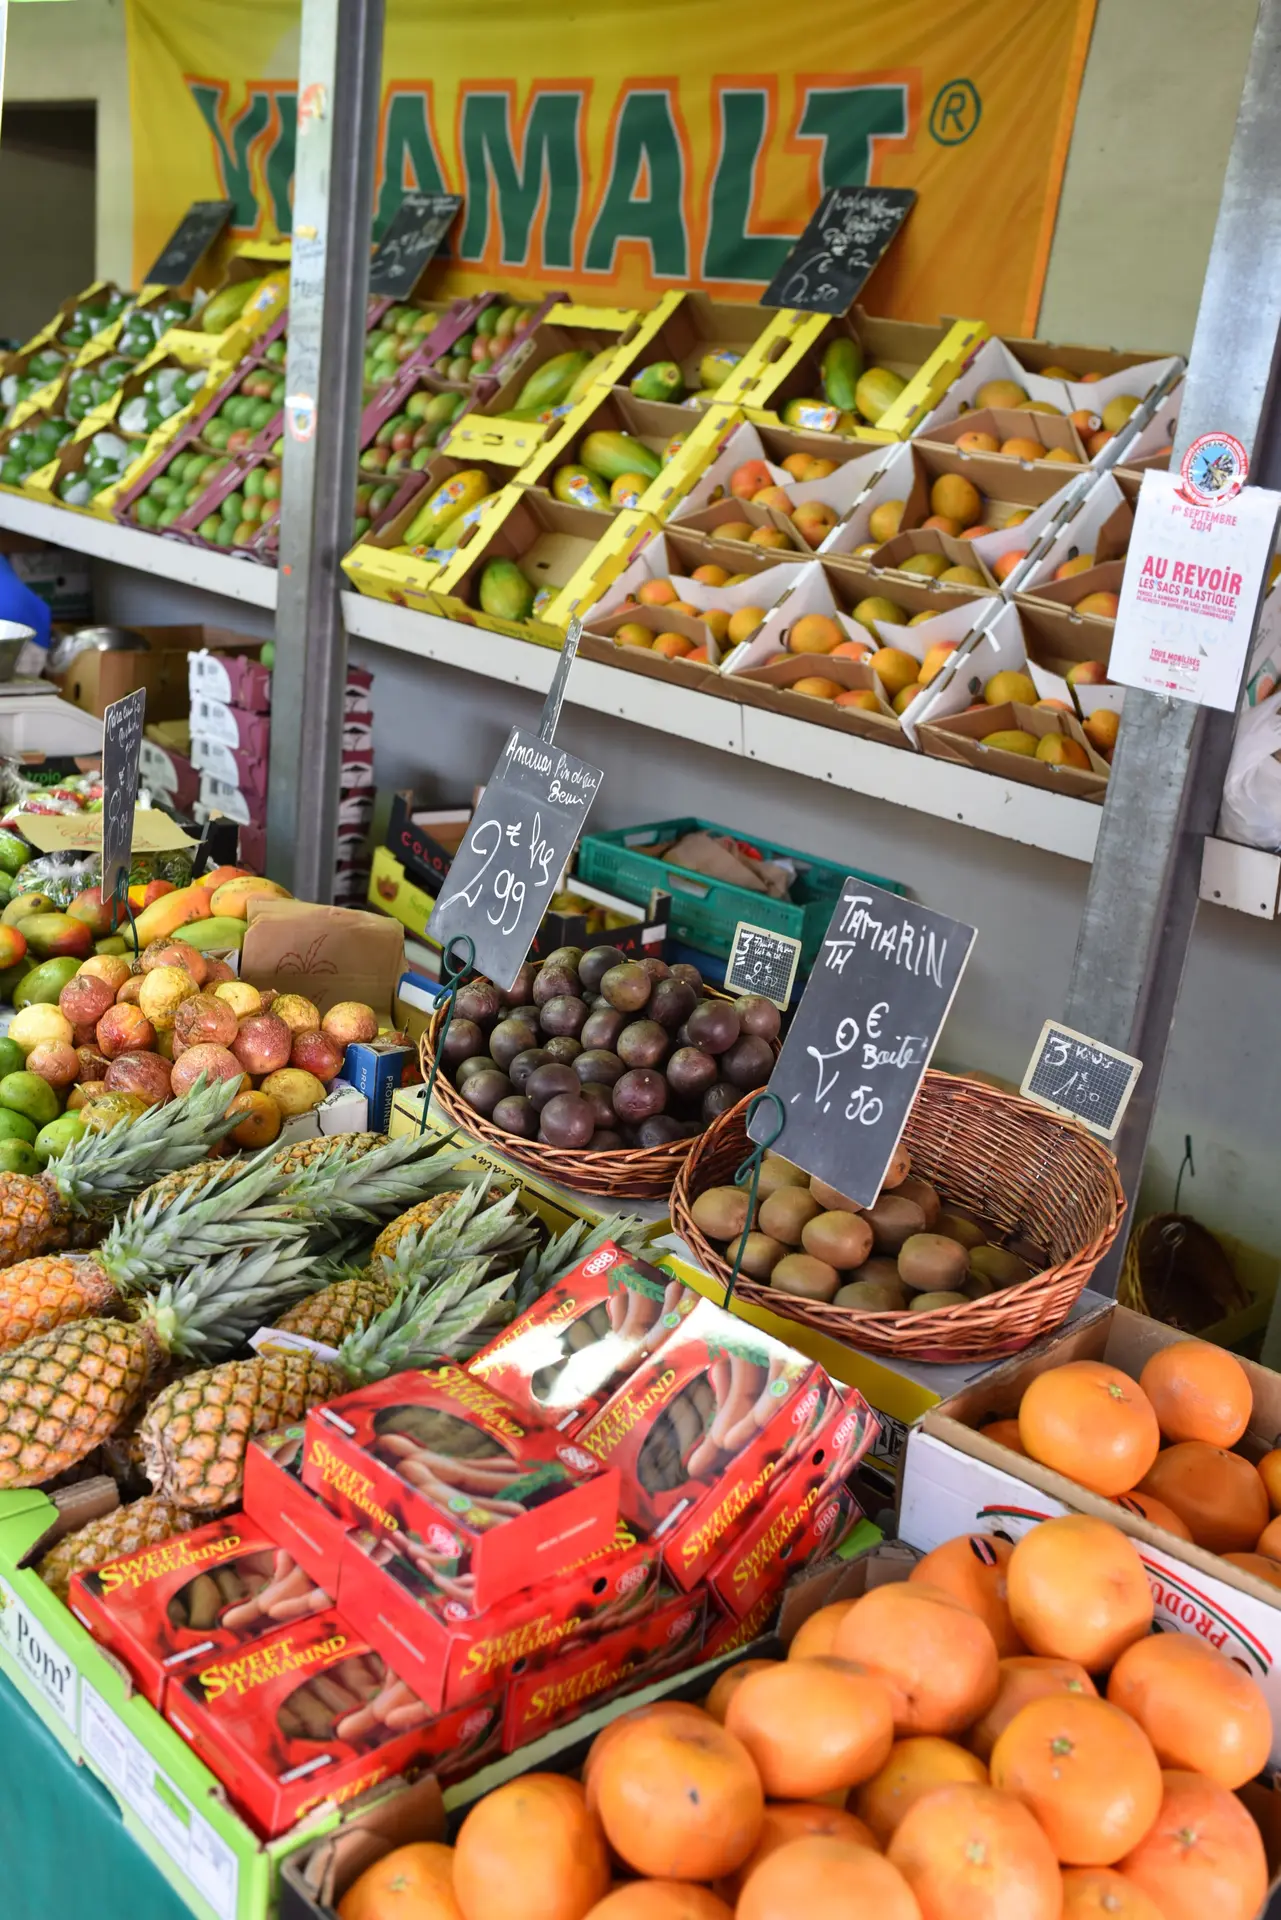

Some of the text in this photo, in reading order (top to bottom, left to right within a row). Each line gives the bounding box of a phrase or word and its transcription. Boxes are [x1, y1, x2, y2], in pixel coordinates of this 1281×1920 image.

[186, 74, 915, 288] VIAMALT
[1183, 506, 1238, 527] SEPTEMBRE
[1190, 518, 1212, 533] 2014
[1138, 577, 1155, 590] LES
[1156, 580, 1181, 596] SACS
[1141, 555, 1169, 580] AU
[1151, 648, 1166, 658] TOUS
[401, 831, 450, 876] COLO
[1044, 1036, 1073, 1067] 3
[360, 1067, 368, 1094] PRO
[382, 1075, 394, 1132] PROMINEN
[582, 1390, 635, 1453] WEET
[307, 1440, 376, 1493] SWEET
[321, 1466, 400, 1532] TAMARIND
[681, 1478, 744, 1571] SWEET
[702, 1461, 777, 1554] TAMARIND
[732, 1505, 790, 1597] SWEET
[751, 1486, 820, 1580] TAMARIND
[98, 1538, 191, 1596] SWEET
[129, 1535, 242, 1589] TAMARIND
[1148, 1577, 1230, 1651] PRODU
[199, 1638, 294, 1702] SWEET
[234, 1635, 347, 1695] TAMARIND
